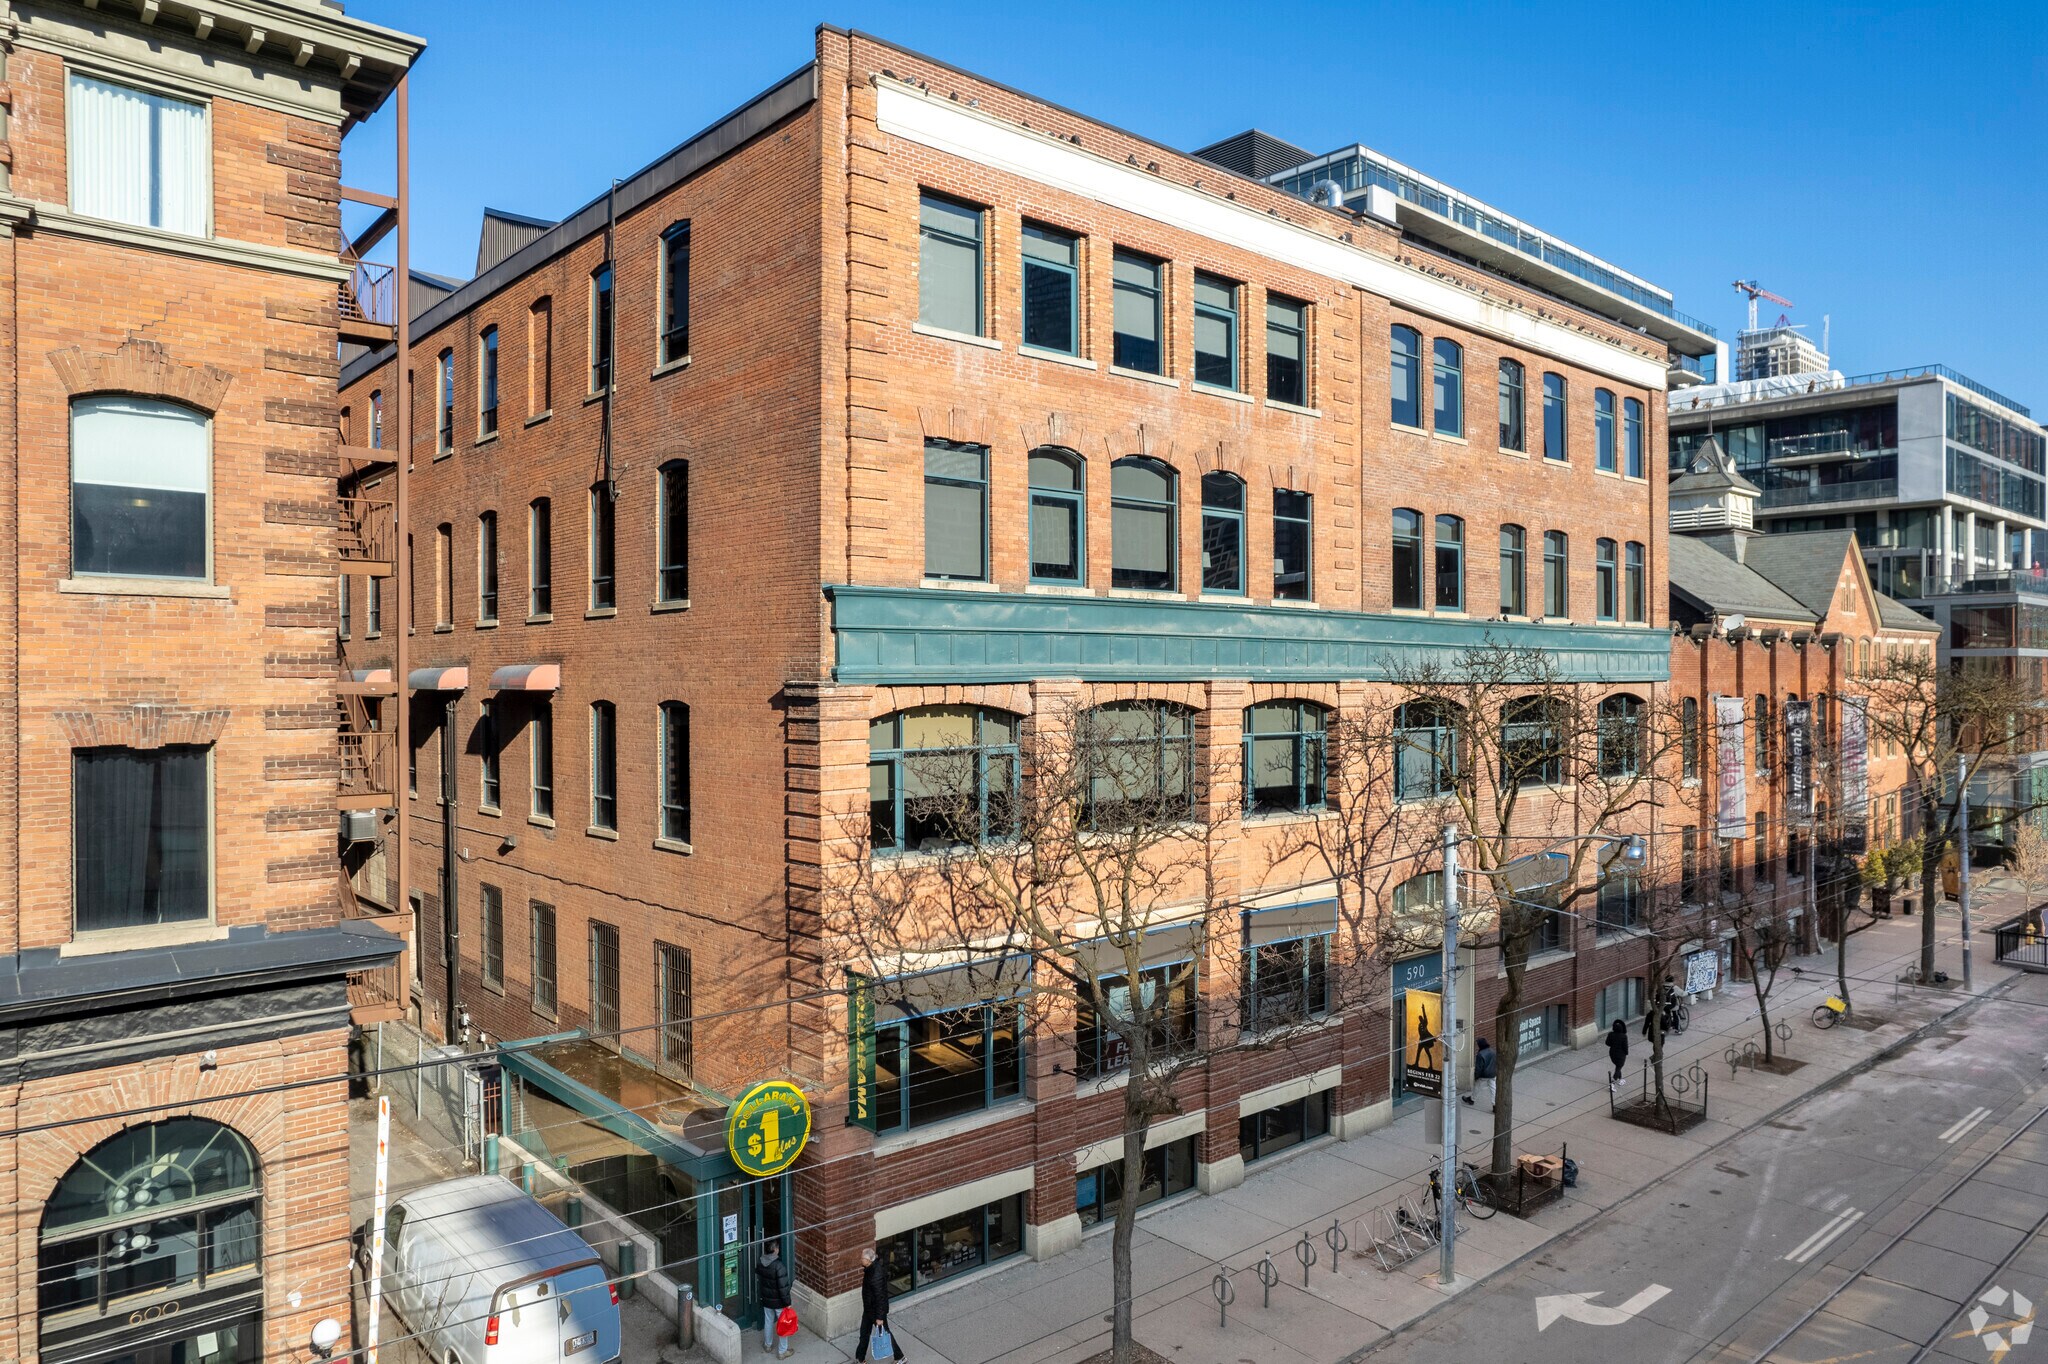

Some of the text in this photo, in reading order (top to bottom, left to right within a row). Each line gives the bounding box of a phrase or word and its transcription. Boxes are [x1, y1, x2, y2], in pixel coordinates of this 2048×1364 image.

[1729, 795, 1737, 824] SOCIAL
[1406, 964, 1425, 981] 590
[1529, 1016, 1541, 1028] Space
[1407, 1069, 1425, 1077] BEGINS
[738, 1091, 800, 1129] DOLLARAMA
[129, 1301, 180, 1326] 600
